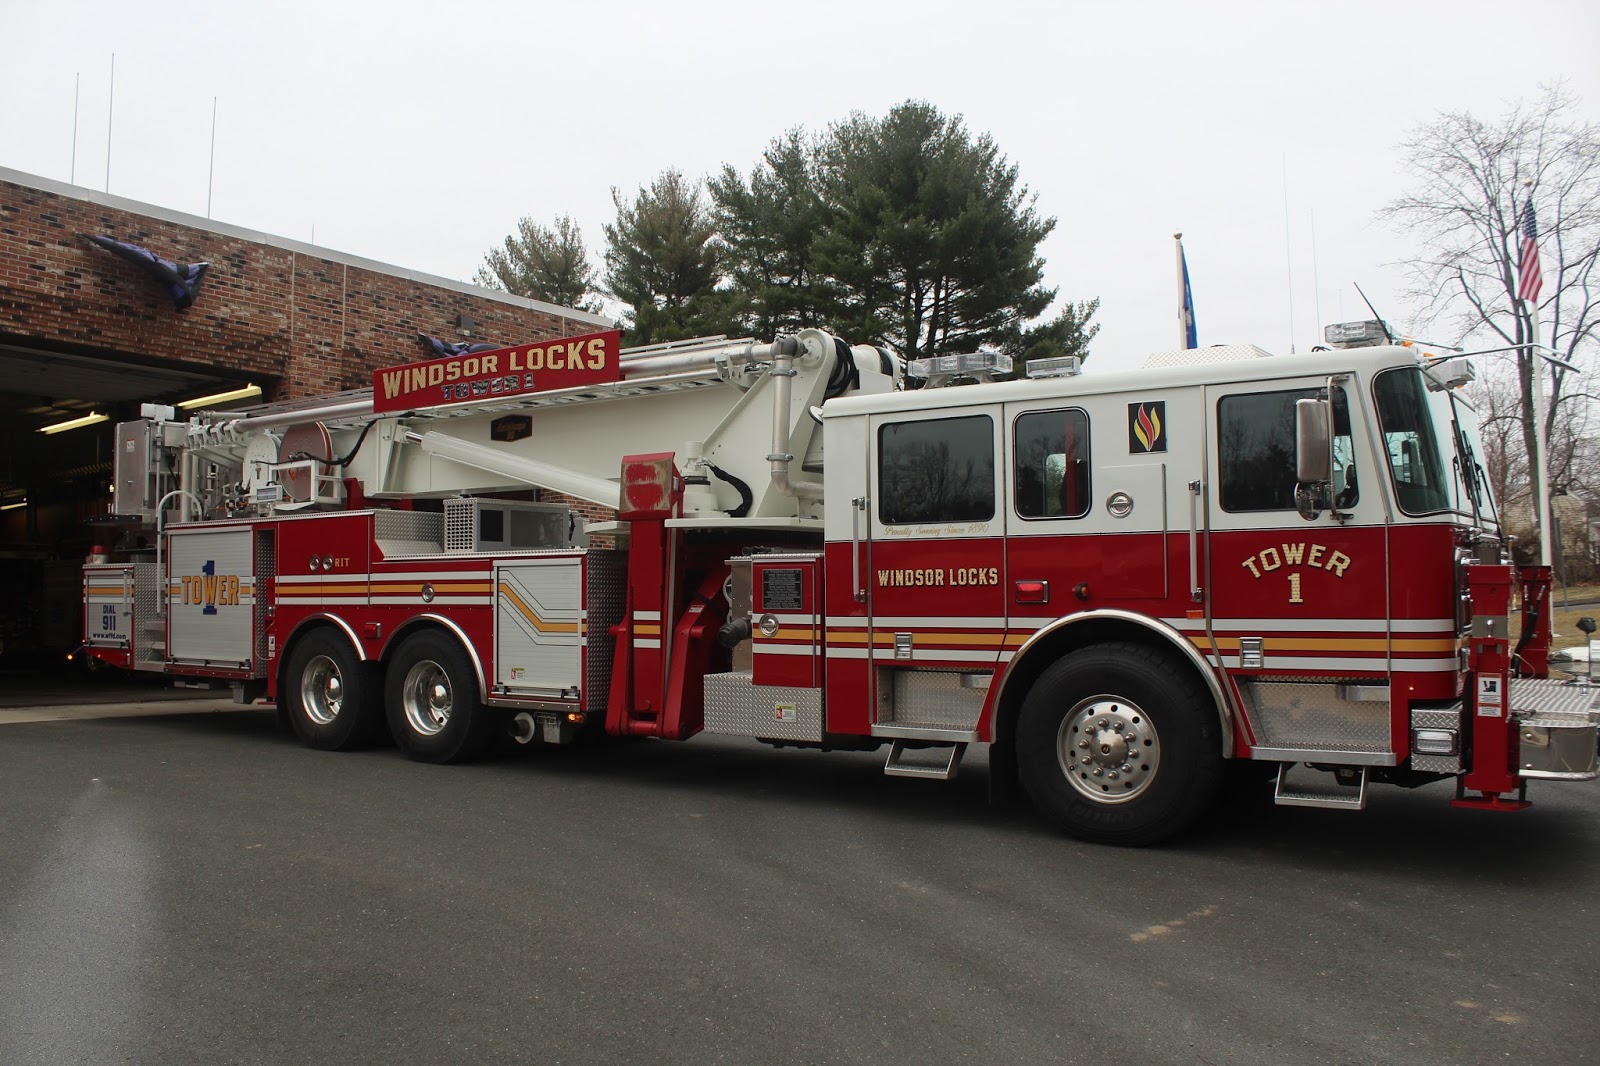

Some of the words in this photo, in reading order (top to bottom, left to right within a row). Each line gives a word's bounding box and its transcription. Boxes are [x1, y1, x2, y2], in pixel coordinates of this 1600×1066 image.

[382, 355, 498, 400] WINDSOR
[509, 338, 605, 370] LOCKS
[441, 375, 521, 400] TOWER
[523, 373, 535, 389] 1
[883, 526, 912, 537] Proudly
[944, 525, 965, 534] Since
[968, 523, 989, 533] 1890
[334, 557, 350, 567] RIT
[1242, 543, 1351, 579] TOWER
[878, 569, 944, 586] WINDSOR
[949, 568, 998, 585] LOCKS
[1287, 572, 1304, 603] 1
[182, 575, 239, 605] TOWER
[103, 605, 116, 614] DIAL
[102, 615, 116, 630] 911
